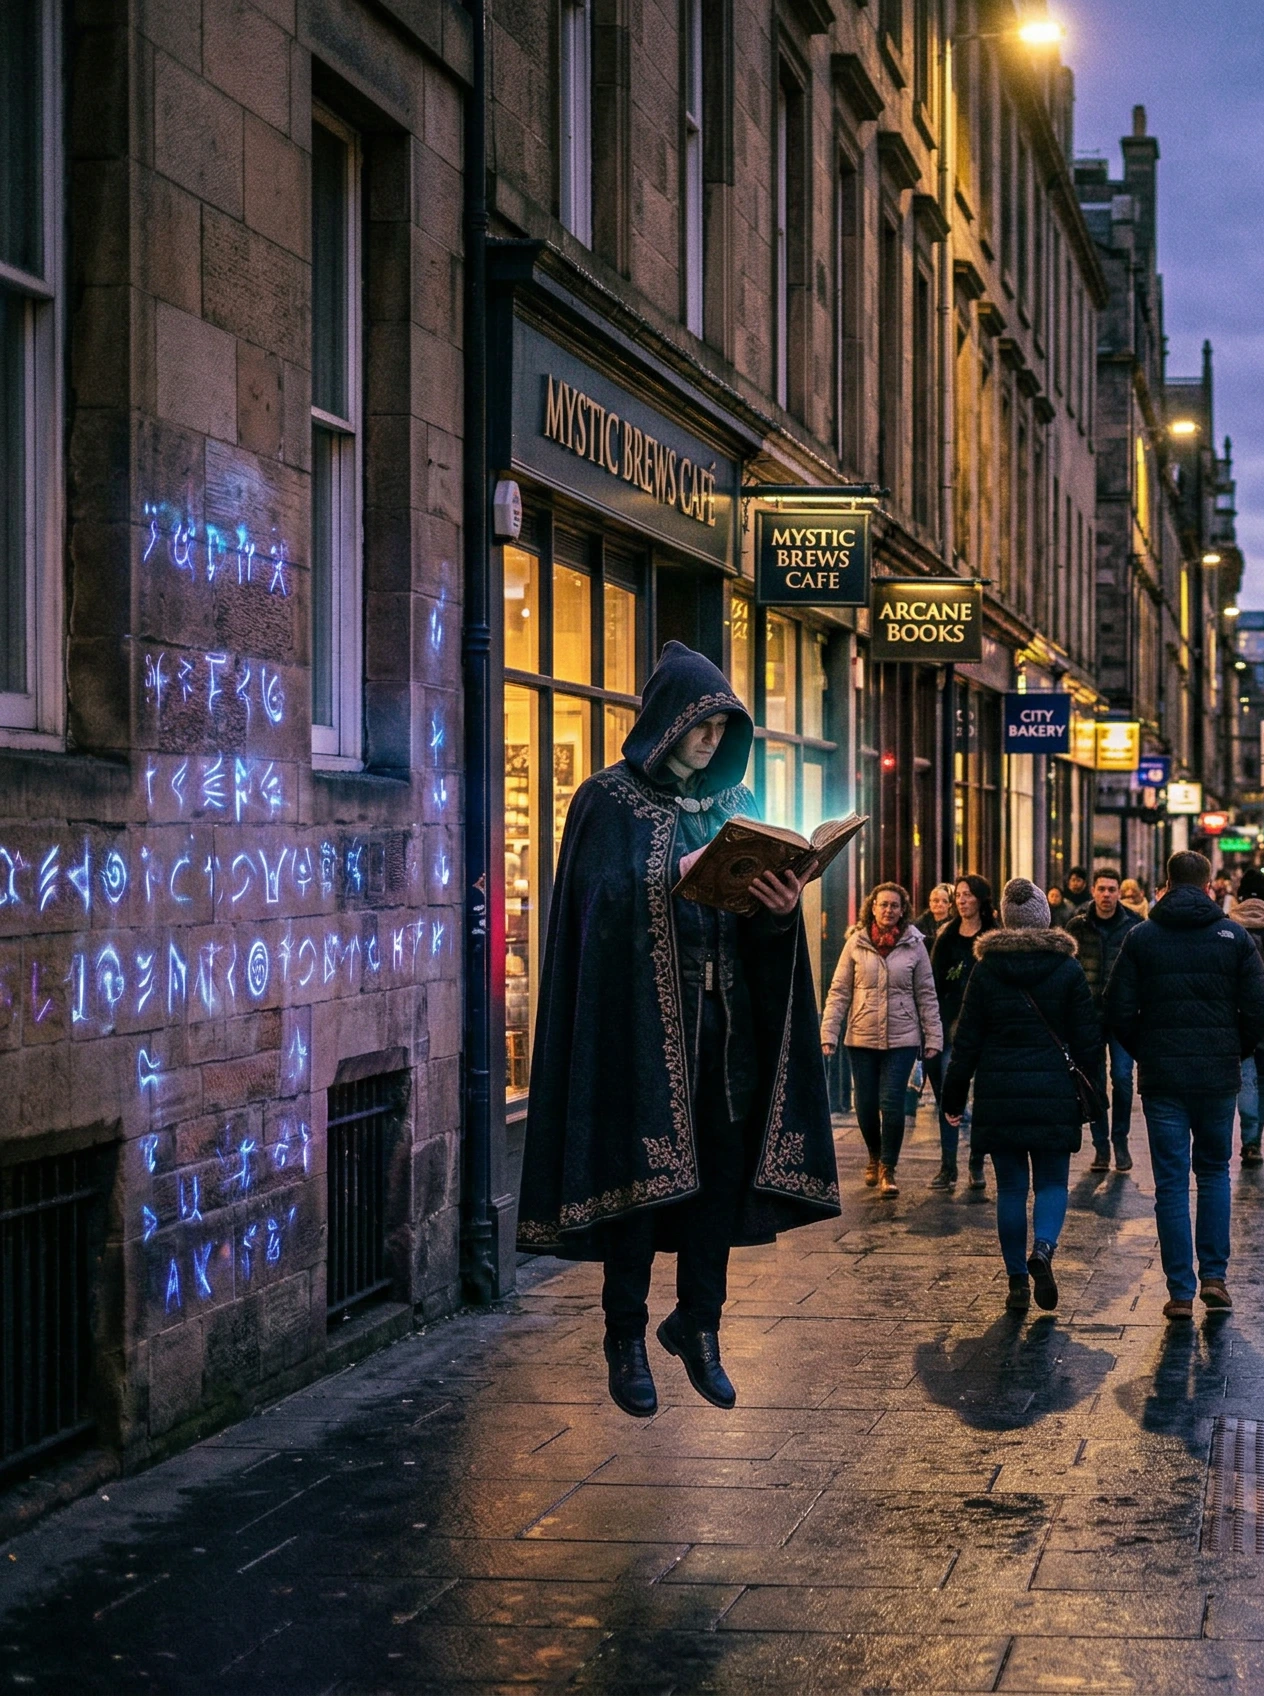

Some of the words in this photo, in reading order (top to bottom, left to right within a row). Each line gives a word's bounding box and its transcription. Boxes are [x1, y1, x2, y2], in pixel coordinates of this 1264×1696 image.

[544, 373, 620, 475] MYSTIC
[623, 420, 677, 506] BREWS
[680, 457, 717, 528] CAFÉ
[771, 528, 856, 548] MYSTIC
[776, 549, 850, 568] BREWS
[785, 571, 840, 589] CAFE
[879, 601, 973, 621] ARCANE
[887, 623, 965, 643] BOOKS
[1020, 709, 1055, 723] CITY
[1008, 724, 1066, 738] BAKERY
